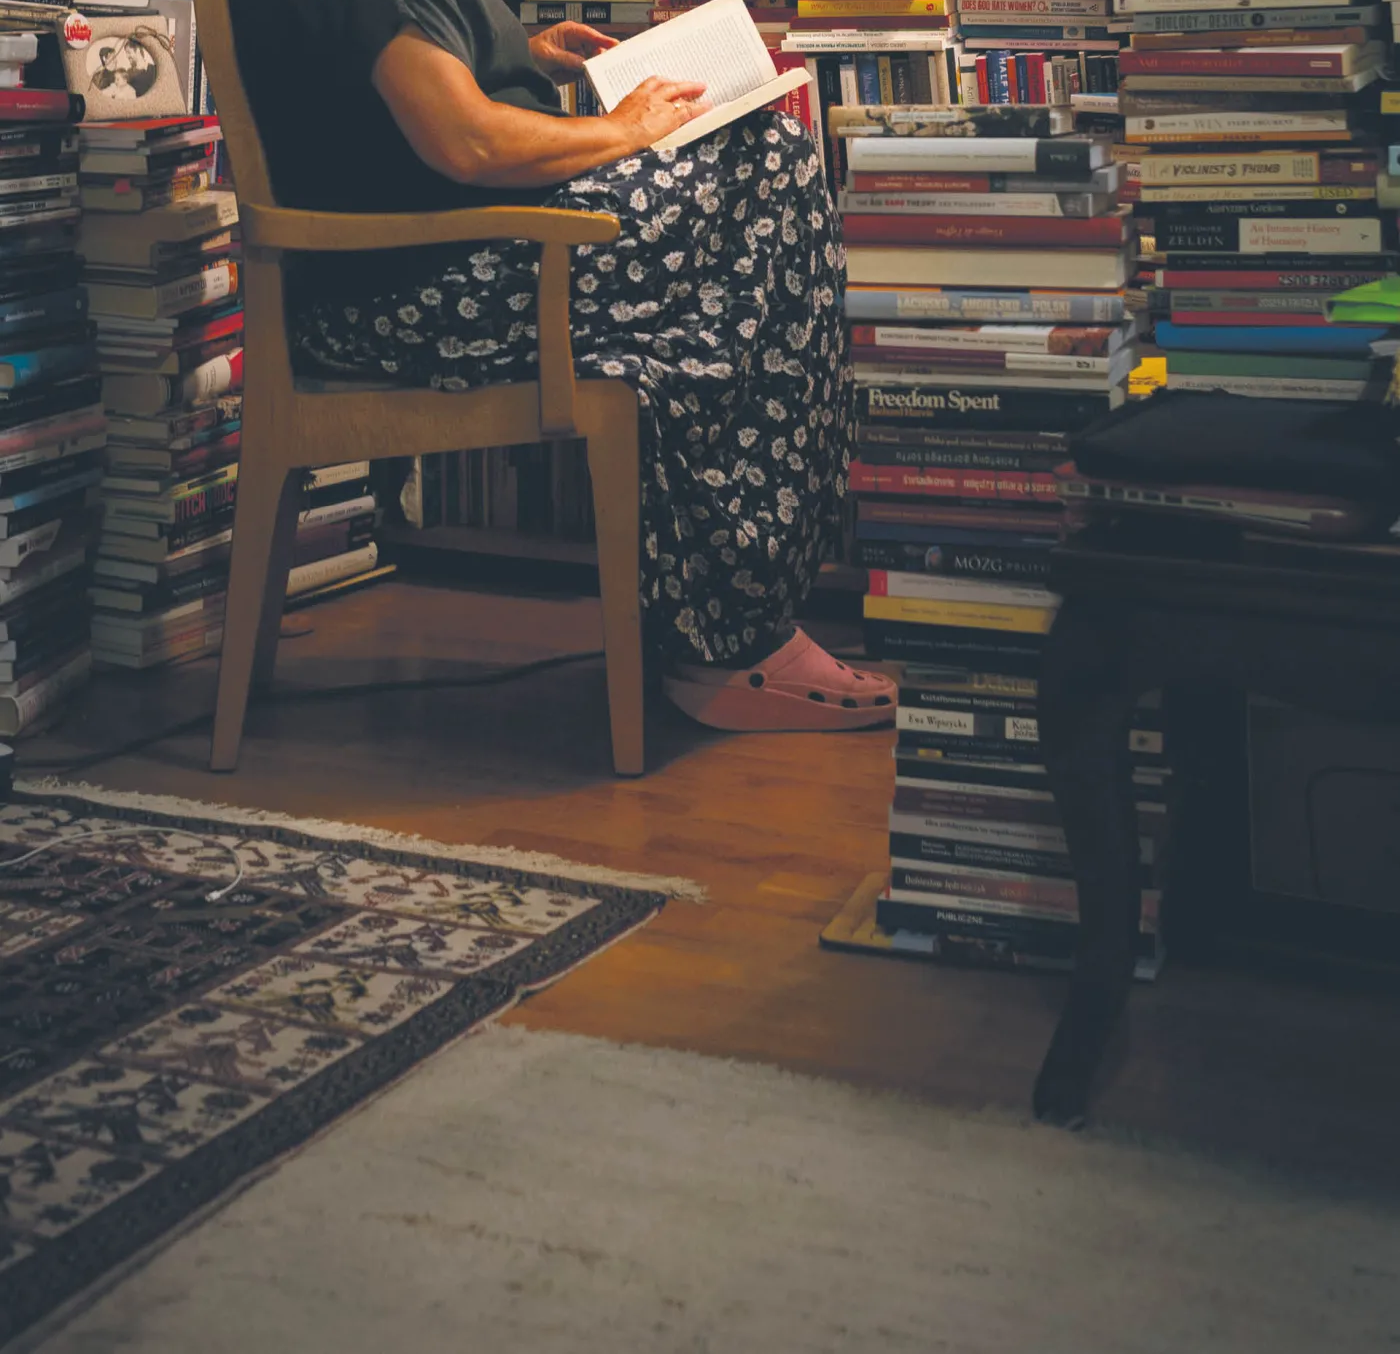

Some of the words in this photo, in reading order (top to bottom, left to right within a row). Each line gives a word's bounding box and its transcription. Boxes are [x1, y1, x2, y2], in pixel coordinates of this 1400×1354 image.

[962, 2, 976, 11] DOES
[977, 1, 991, 11] GOD
[991, 1, 1007, 11] HATE
[1008, 0, 1036, 11] WOMEN?
[1155, 14, 1198, 29] BIOLOGY
[1209, 12, 1245, 27] DESIRE
[999, 56, 1008, 86] HALF
[1193, 118, 1222, 129] WIN
[1253, 118, 1293, 126] ARGUMENT
[1242, 162, 1281, 175] THUMB
[1317, 188, 1354, 198] USED
[1249, 224, 1264, 233] An
[1267, 224, 1303, 233] Intimate
[1306, 224, 1340, 235] History
[1168, 235, 1224, 246] ZELDIN
[1249, 236, 1259, 245] of
[1261, 236, 1307, 247] Humanity
[868, 387, 946, 409] Freedom
[948, 390, 1000, 413] Spent
[955, 555, 1003, 571] MÓZG
